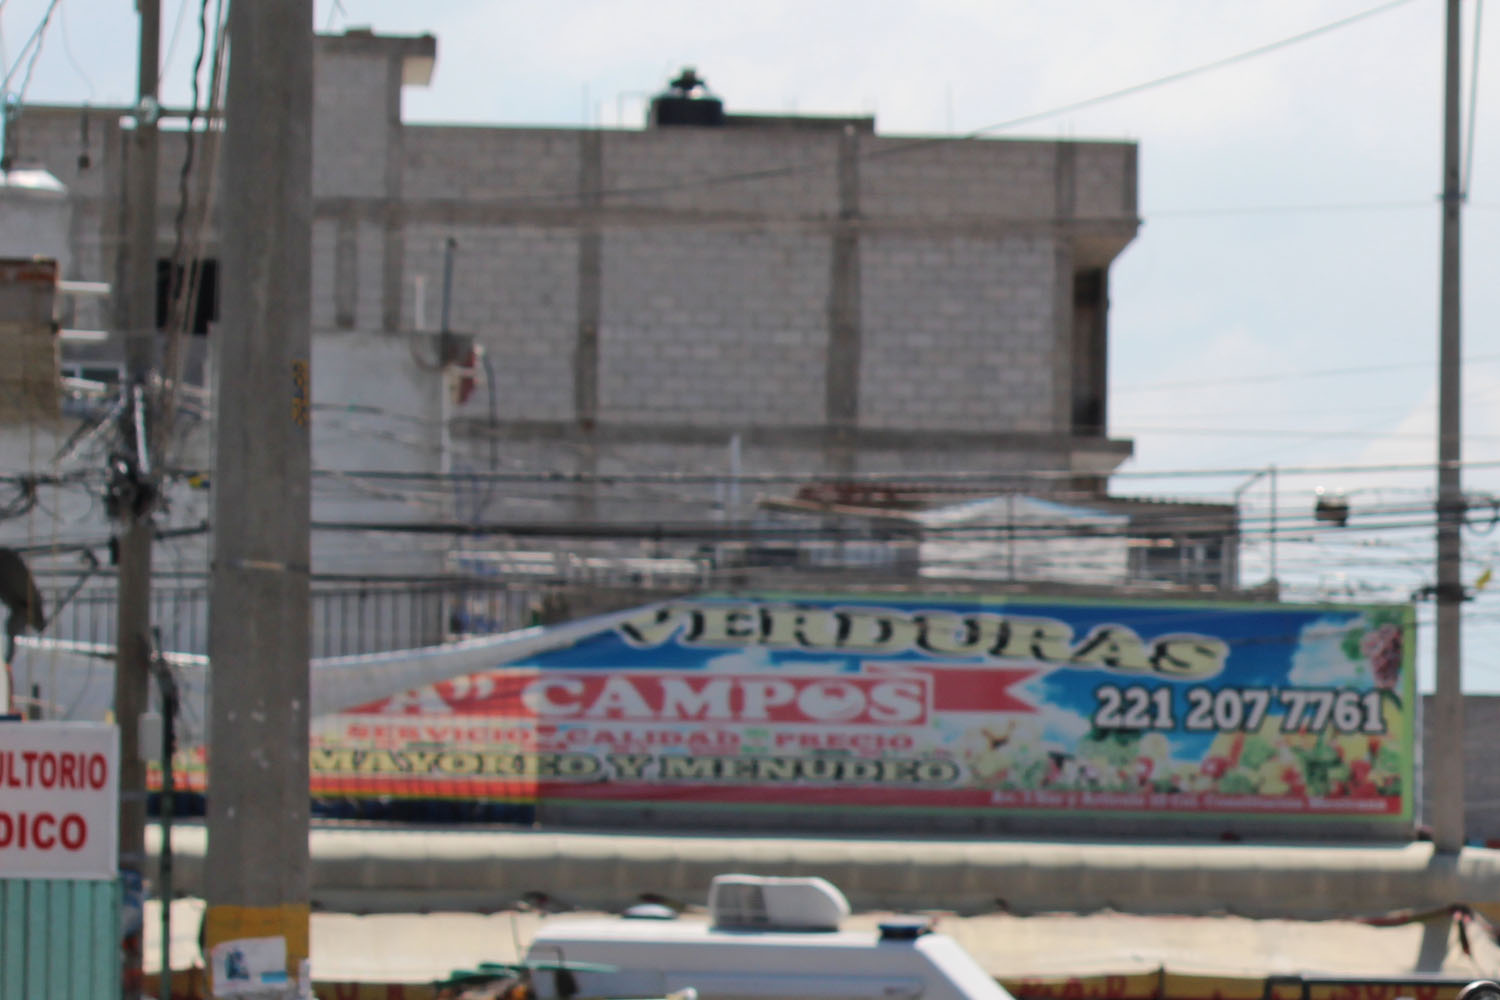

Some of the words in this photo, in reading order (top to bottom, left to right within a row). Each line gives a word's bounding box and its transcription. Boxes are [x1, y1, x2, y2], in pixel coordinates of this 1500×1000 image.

[618, 602, 1230, 678] VERDURAS
[521, 677, 923, 724] CAMPOS
[1095, 687, 1173, 729] 221
[1186, 688, 1270, 731] 207
[1280, 689, 1386, 733] 7761
[346, 723, 534, 744] SERVICIO
[567, 728, 740, 748] CALIDAD
[775, 732, 913, 750] PRECIO
[0, 751, 107, 790] LTORIO
[309, 749, 598, 780] MAYOREO
[607, 754, 655, 781] Y
[657, 755, 960, 784] MENUDEO
